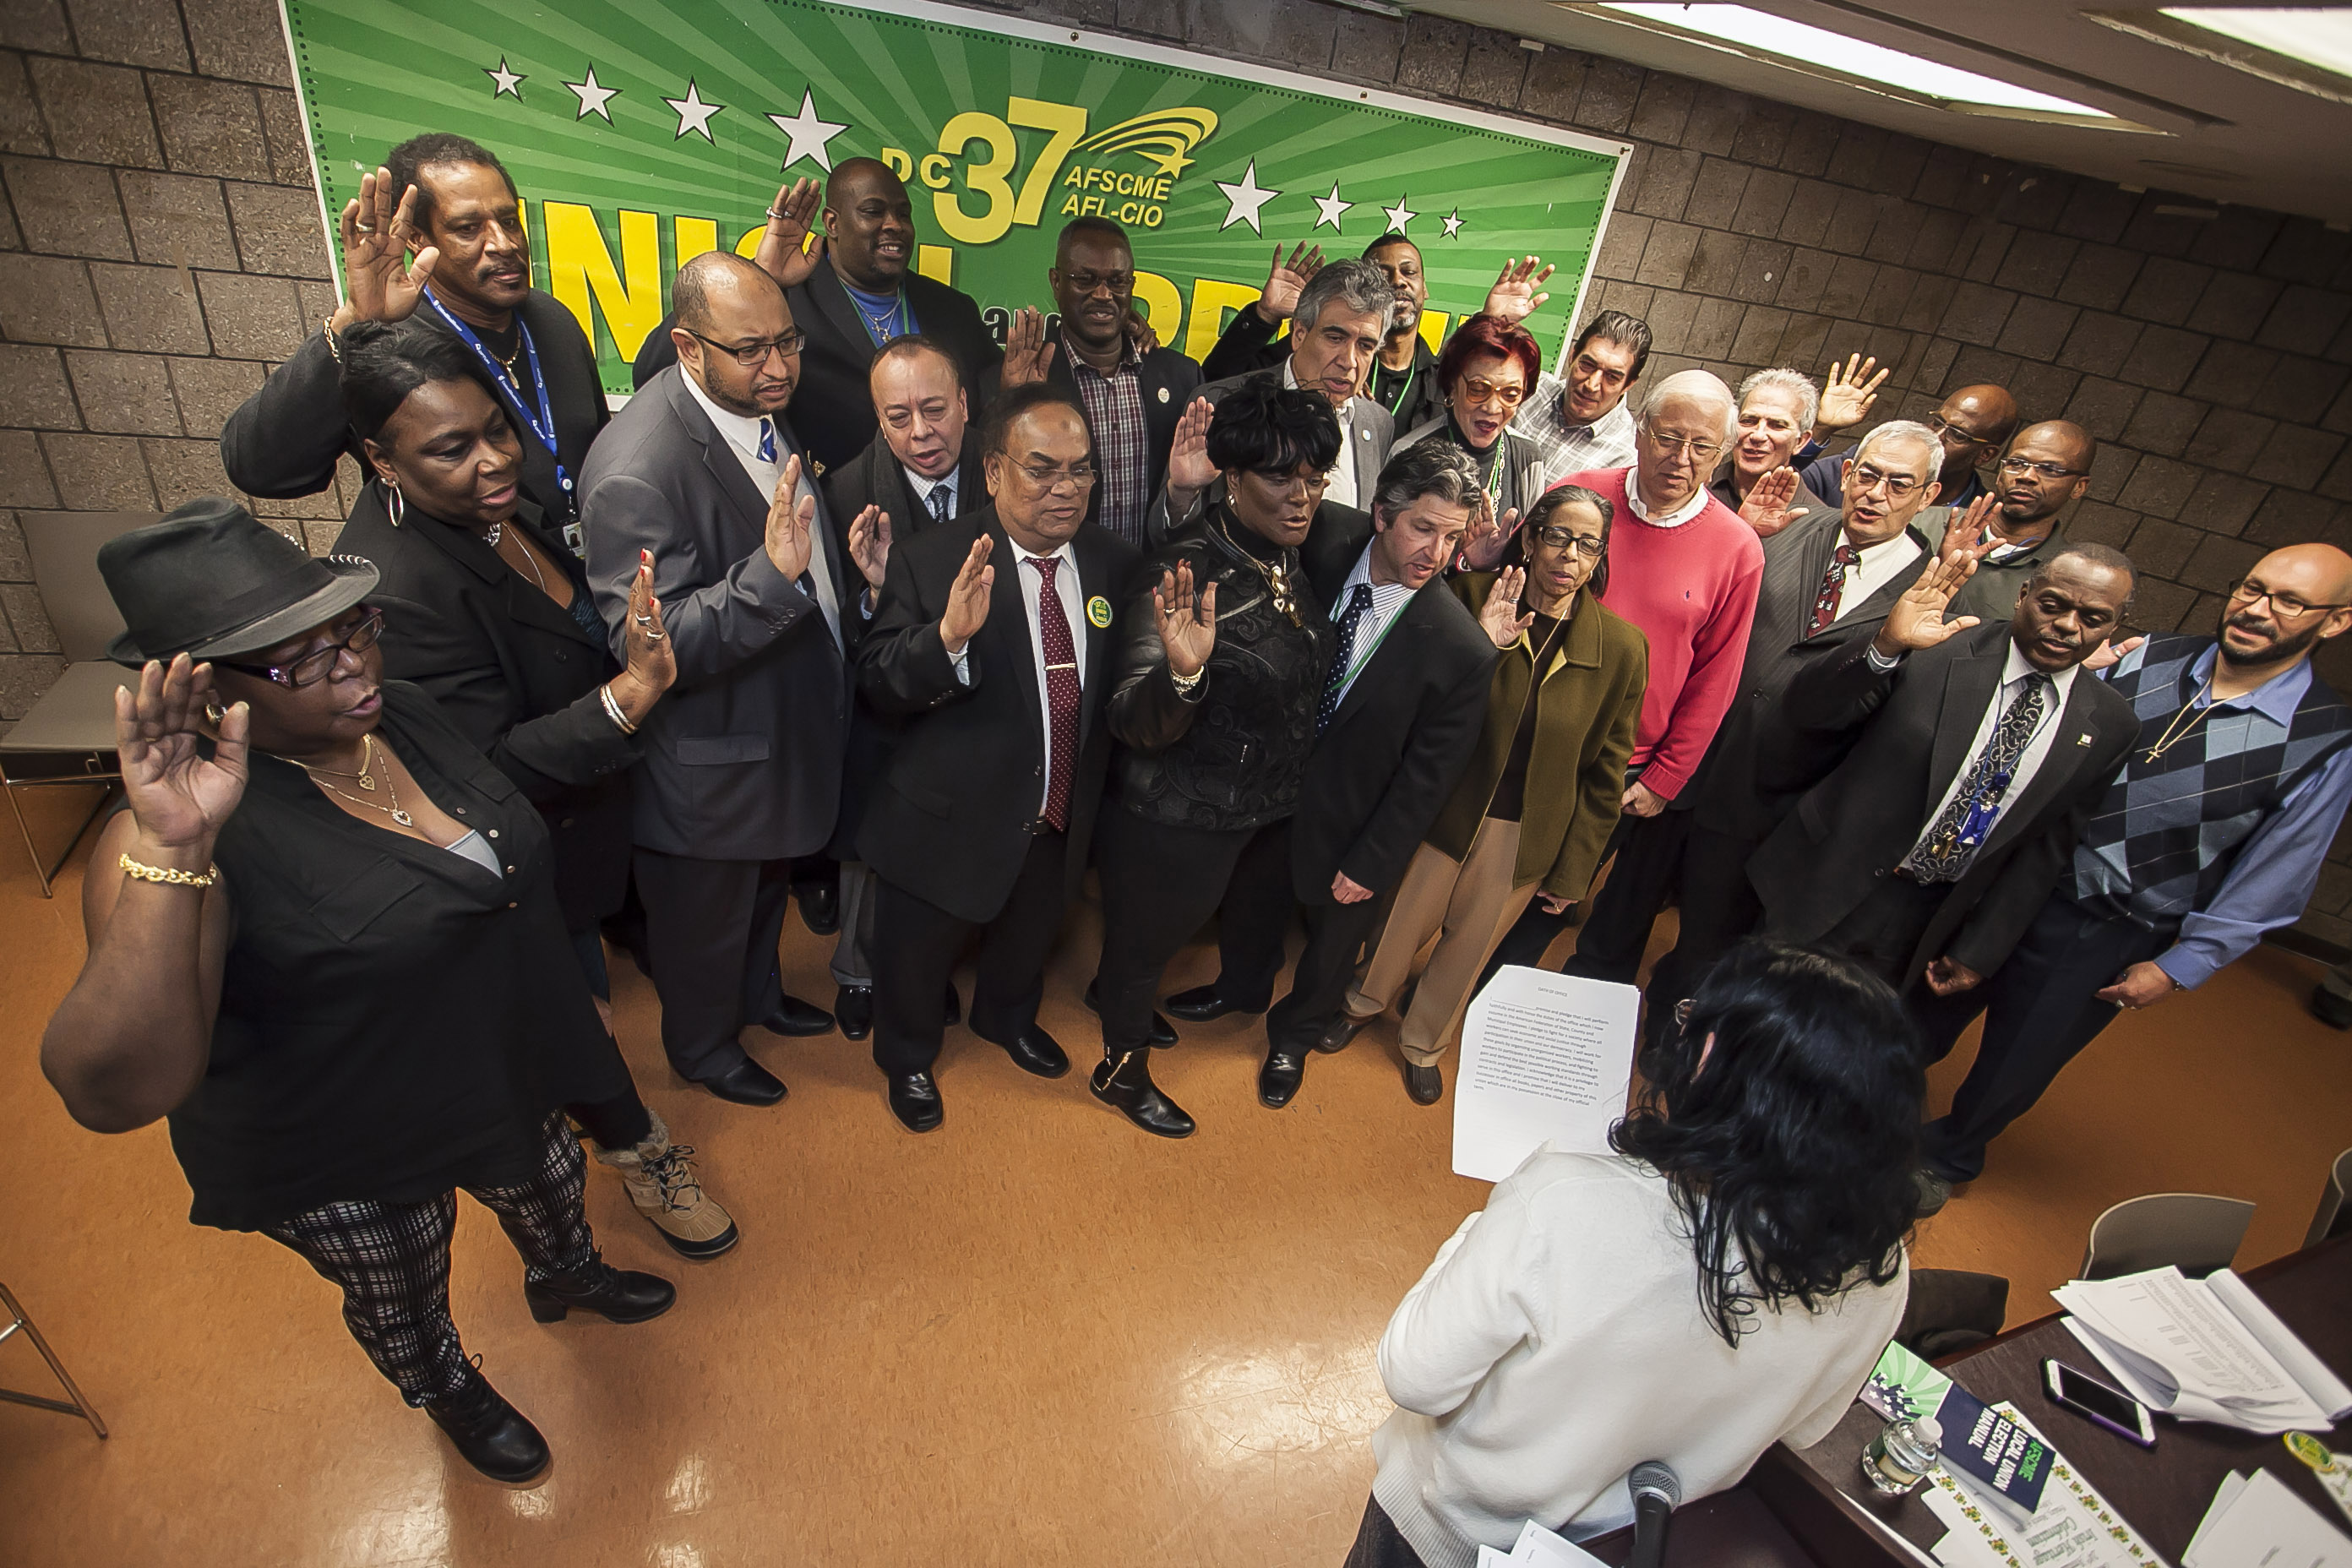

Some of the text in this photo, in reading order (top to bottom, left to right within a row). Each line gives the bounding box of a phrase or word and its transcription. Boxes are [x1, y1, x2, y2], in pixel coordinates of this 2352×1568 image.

[933, 95, 1088, 244] 37
[1064, 166, 1172, 201] AFSCME
[1061, 193, 1163, 228] AFL-CIO
[1968, 1407, 1997, 1448] MANUAL
[1983, 1418, 2012, 1466] ELECTION
[1993, 1429, 2028, 1491] LOCAL UNION
[2018, 1440, 2044, 1482] AFSCME
